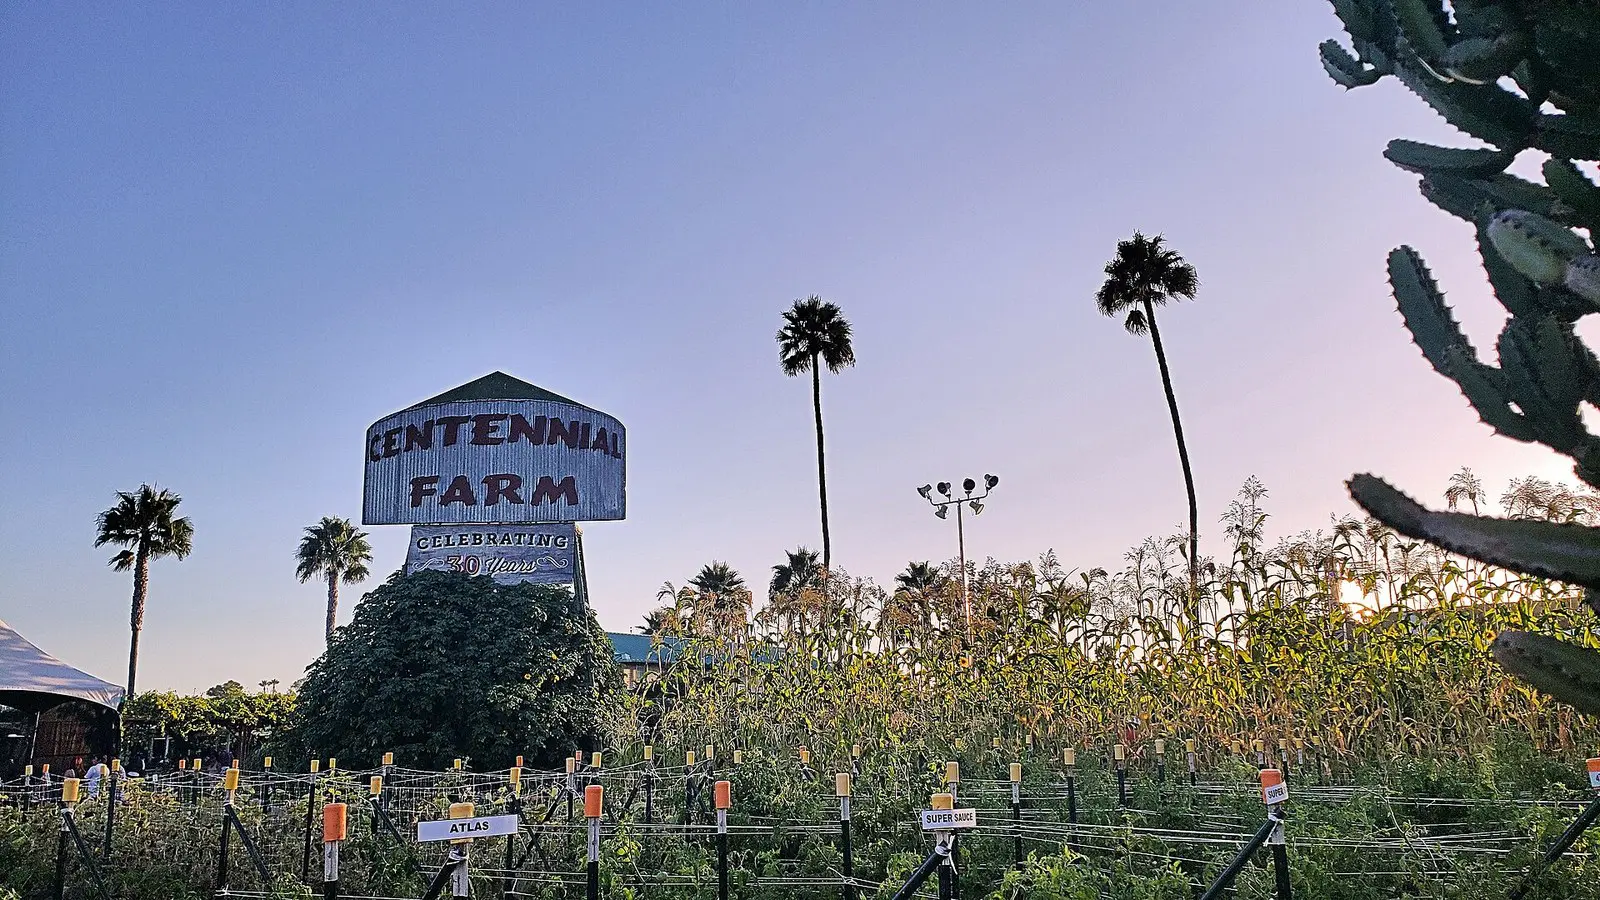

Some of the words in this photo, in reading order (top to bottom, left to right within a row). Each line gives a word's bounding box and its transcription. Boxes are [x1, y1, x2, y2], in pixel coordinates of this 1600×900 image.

[370, 413, 622, 462] CENTENNIAL
[410, 473, 579, 508] FARM
[416, 532, 569, 550] CELEBRATING
[447, 555, 480, 576] 30
[485, 556, 537, 577] Years
[450, 821, 489, 833] ATLAS
[926, 813, 953, 824] SUPER
[954, 812, 973, 822] SAUCE
